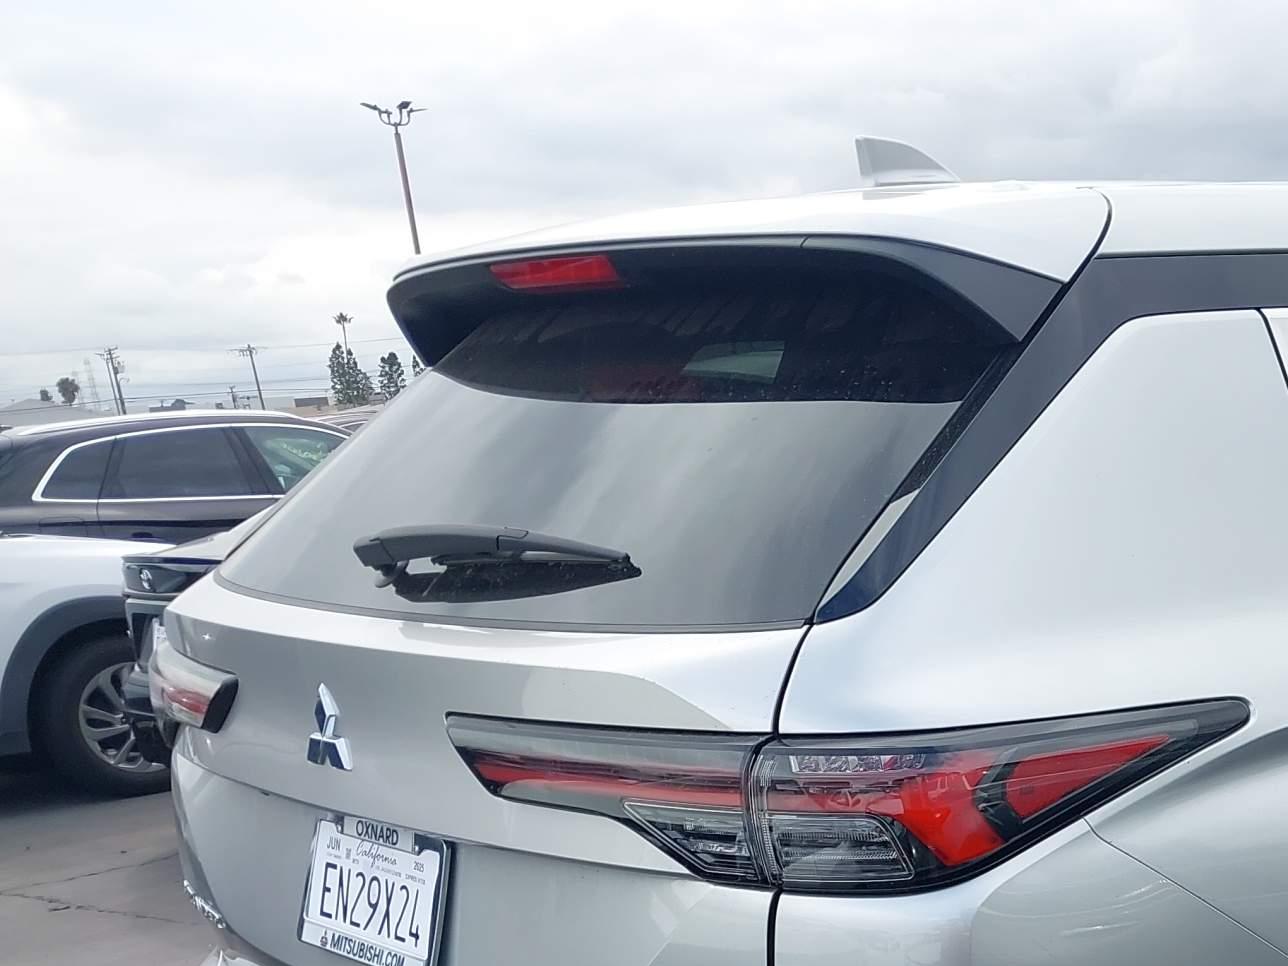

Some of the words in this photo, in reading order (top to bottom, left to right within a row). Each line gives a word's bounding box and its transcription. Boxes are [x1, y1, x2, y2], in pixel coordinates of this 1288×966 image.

[326, 836, 342, 851] JUN
[355, 820, 399, 846] OXNARD
[355, 839, 398, 868] California
[319, 862, 420, 948] EN29X24
